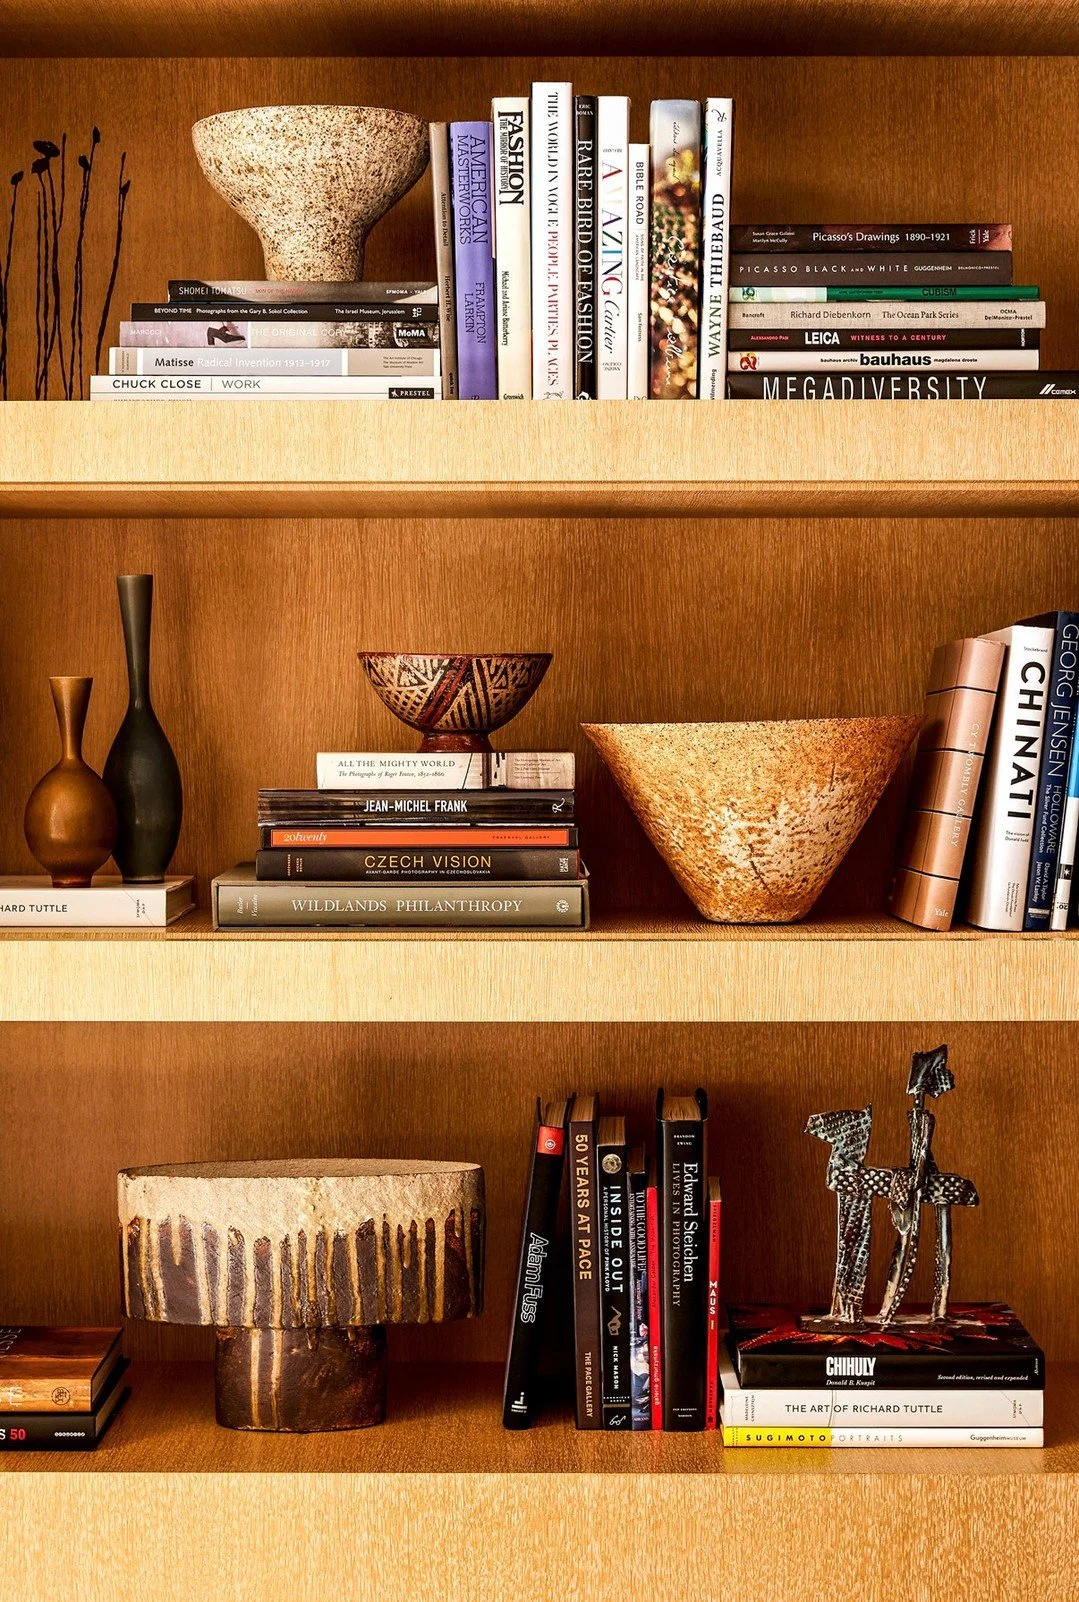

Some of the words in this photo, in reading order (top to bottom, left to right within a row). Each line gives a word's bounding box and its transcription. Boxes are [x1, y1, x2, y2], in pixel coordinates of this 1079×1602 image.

[547, 92, 558, 118] THE
[500, 118, 508, 131] THE
[500, 132, 508, 155] MIRROR
[547, 121, 558, 167] WORLD
[498, 111, 524, 205] FASHION
[500, 156, 508, 165] OF
[577, 139, 593, 190] RARE
[500, 166, 509, 190] HISTORY
[547, 171, 558, 183] IN
[635, 162, 644, 190] BIBLE
[457, 135, 471, 244] MASTERWORKS
[470, 136, 488, 243] AMERICAN
[547, 187, 558, 227] VOGUE
[635, 196, 644, 224] ROAD
[577, 197, 593, 244] BIRD
[601, 160, 623, 296] AMAZING
[710, 194, 725, 288] THIEBAUD
[813, 232, 853, 242] Picasso's
[856, 232, 899, 243] Drawings
[982, 230, 990, 243] Yale
[577, 250, 593, 274] OF
[179, 286, 208, 296] SHOMEI
[211, 286, 247, 296] TOMATSU
[922, 288, 957, 296] CUBISM
[464, 293, 474, 333] LARKIN
[476, 282, 486, 344] FRAMPTON
[577, 280, 592, 363] FASHION
[790, 310, 821, 319] Richard
[823, 310, 872, 319] Diebenkorn
[882, 311, 895, 319] The
[897, 311, 919, 319] Ocean
[921, 311, 936, 319] Park
[938, 311, 959, 319] Series
[252, 328, 269, 337] THE
[272, 328, 318, 337] ORIGINAL
[321, 328, 346, 337] COPY
[398, 329, 426, 338] MoMA
[604, 300, 620, 354] Cartier
[708, 295, 722, 358] WAYNE
[804, 331, 841, 345] LEICA
[155, 358, 194, 367] Matisse
[197, 358, 233, 367] Radical
[235, 358, 281, 367] Invention
[547, 340, 558, 386] PLACES
[860, 353, 931, 366] bauhaus
[112, 380, 156, 389] CHUCK
[161, 380, 202, 389] CLOSE
[221, 380, 261, 389] WORK
[763, 376, 987, 399] MEGADIVERSITY
[1056, 624, 1079, 698] GEORG
[971, 723, 980, 738] CY
[1008, 661, 1046, 818] CHINATI
[1047, 701, 1071, 777] JENSEN
[337, 760, 355, 768] ALL
[356, 760, 376, 768] THE
[379, 760, 418, 768] MIGHTY
[420, 760, 456, 768] WORLD
[960, 742, 977, 795] TWOMBLY
[364, 800, 431, 812] JEAN-MICHEL
[435, 800, 468, 812] FRANK
[950, 799, 966, 847] GALLERY
[1046, 785, 1062, 854] HOLLOWARE
[284, 832, 328, 845] 20twenty
[365, 855, 424, 868] CZECH
[432, 855, 491, 868] VISION
[29, 904, 68, 912] TUTTLE
[292, 899, 387, 912] WILDLANDS
[396, 899, 523, 912] PHILANTHROPY
[934, 907, 949, 917] Yale
[575, 1134, 589, 1152] 50
[576, 1156, 590, 1208] YEARS
[672, 1162, 680, 1196] LIVES
[683, 1162, 699, 1217] Edward
[636, 1190, 645, 1202] TO
[672, 1203, 680, 1215] IN
[577, 1213, 590, 1233] AT
[609, 1185, 622, 1248] INSIDE
[636, 1203, 646, 1221] THE
[636, 1223, 646, 1249] GOOD
[526, 1232, 548, 1282] Adam
[578, 1239, 592, 1279] PACE
[672, 1221, 681, 1306] PHOTOGRAPHY
[683, 1221, 699, 1282] Steichen
[611, 1258, 623, 1292] OUT
[521, 1283, 543, 1323] Fuss
[710, 1280, 718, 1315] MAUS
[825, 1356, 877, 1376] CHIHULY
[856, 1379, 876, 1387] Kuspit
[585, 1386, 593, 1417] GALLERY
[785, 1404, 806, 1412] THE
[810, 1404, 830, 1412] ART
[833, 1404, 848, 1412] OF
[853, 1404, 900, 1412] RICHARD
[904, 1404, 943, 1412] TUTTLE
[10, 1428, 26, 1440] 50
[746, 1434, 826, 1442] SUGIMOTO
[831, 1434, 903, 1442] PORTRAITS
